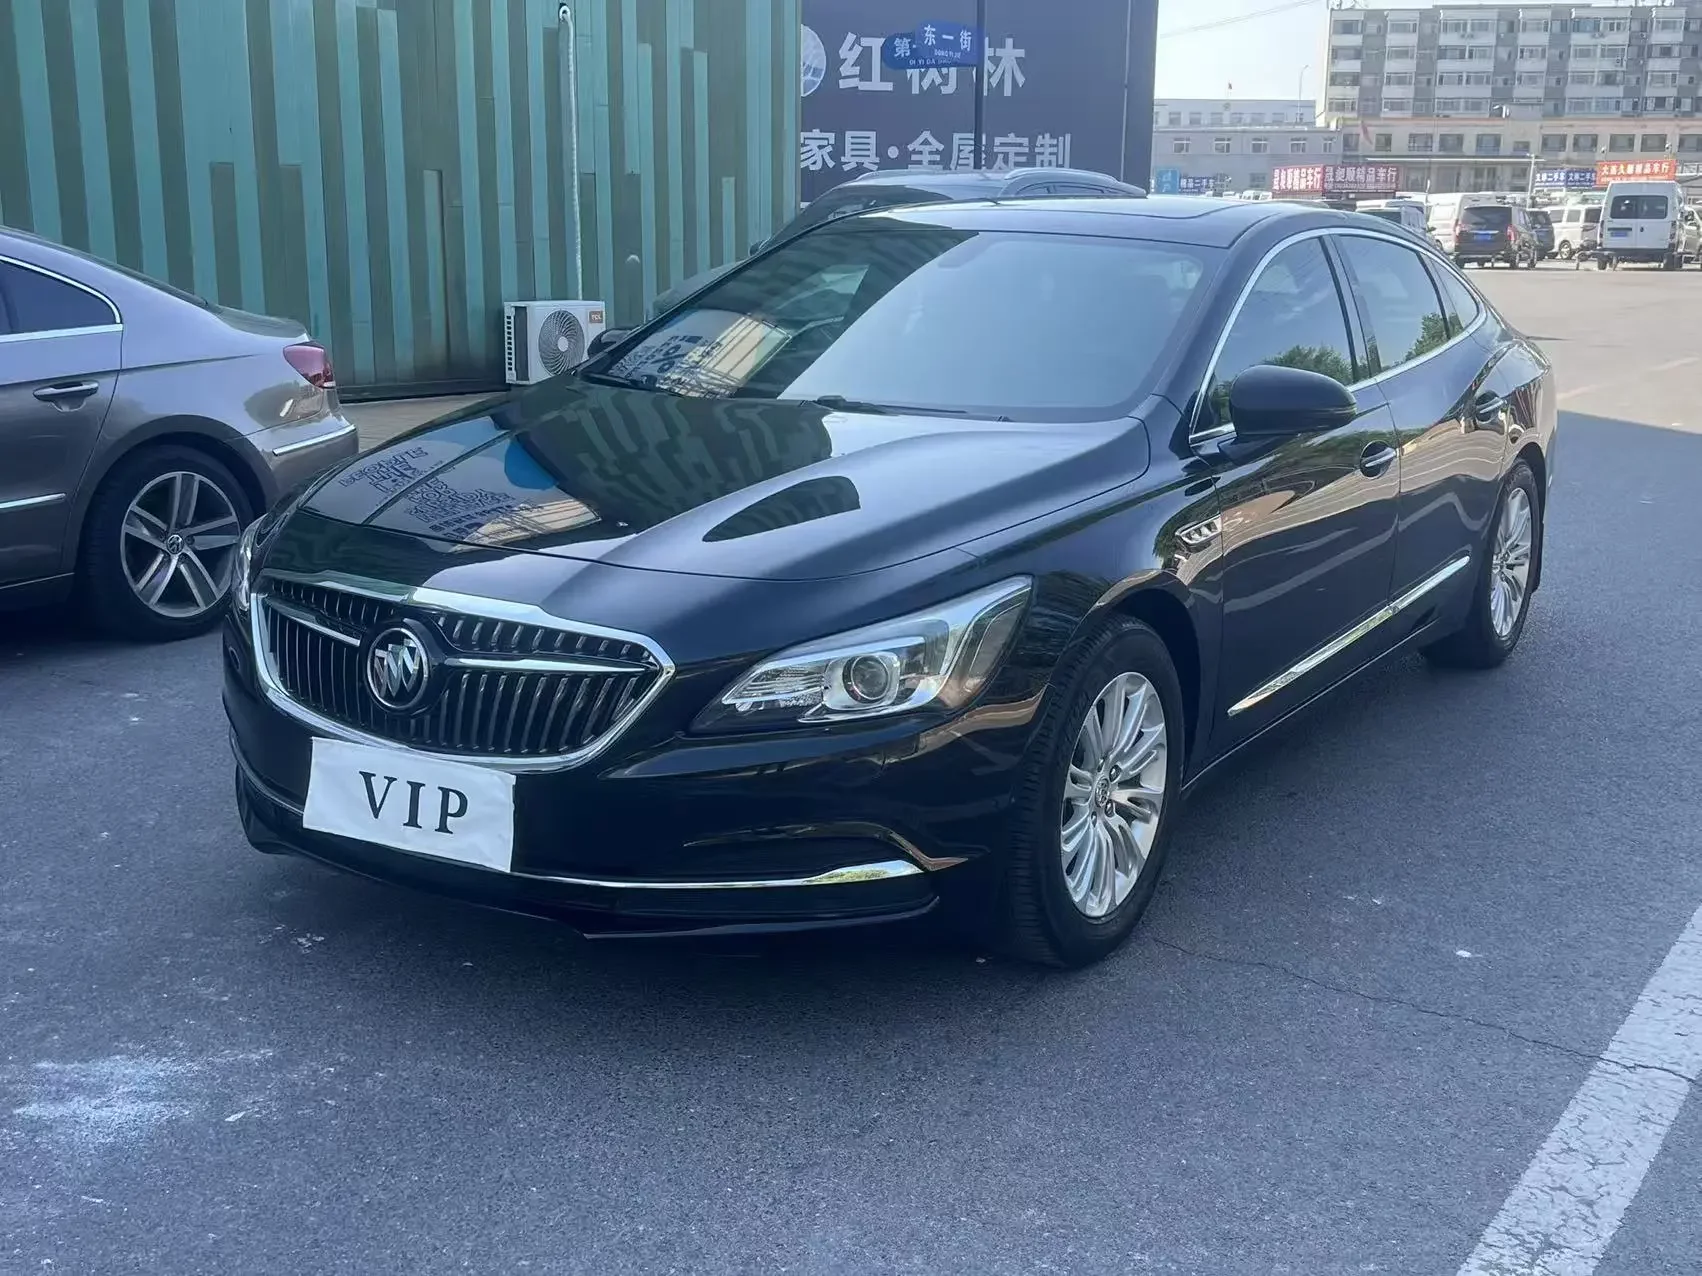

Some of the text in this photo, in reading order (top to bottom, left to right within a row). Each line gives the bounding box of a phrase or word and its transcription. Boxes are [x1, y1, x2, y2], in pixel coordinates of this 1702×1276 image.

[894, 37, 917, 58] 第
[924, 24, 972, 51] 东一街
[359, 771, 468, 834] VIP
